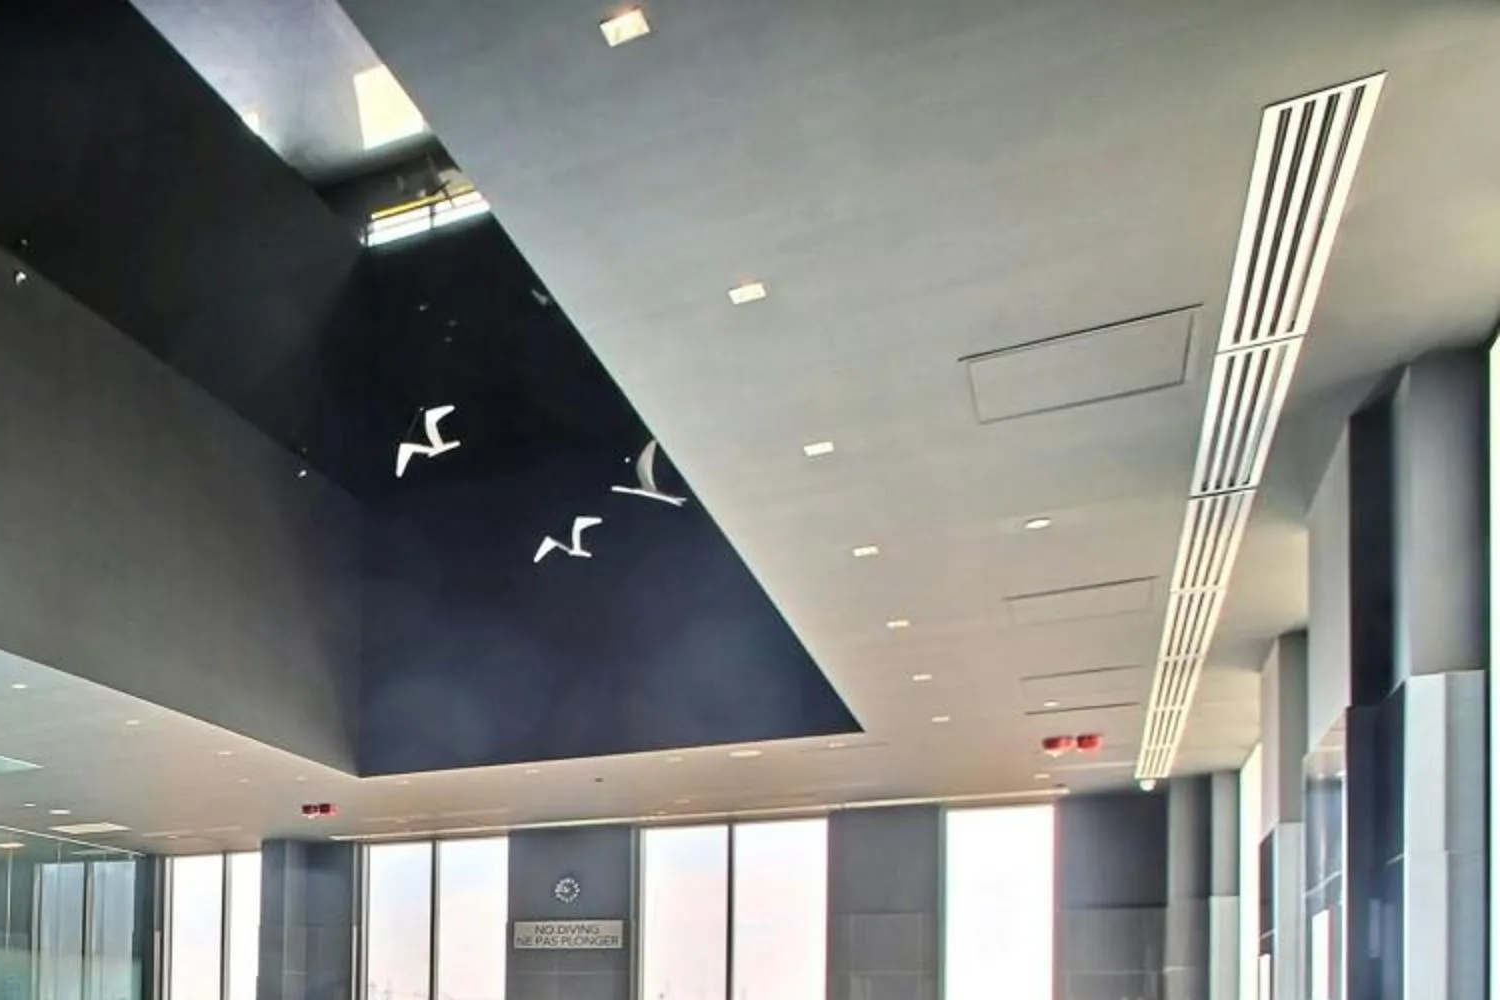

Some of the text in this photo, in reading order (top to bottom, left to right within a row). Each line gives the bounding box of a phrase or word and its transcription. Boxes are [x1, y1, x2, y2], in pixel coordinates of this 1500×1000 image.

[534, 923, 600, 934] NO DIVING
[535, 936, 557, 946] PAS
[561, 935, 619, 946] PLONGER
